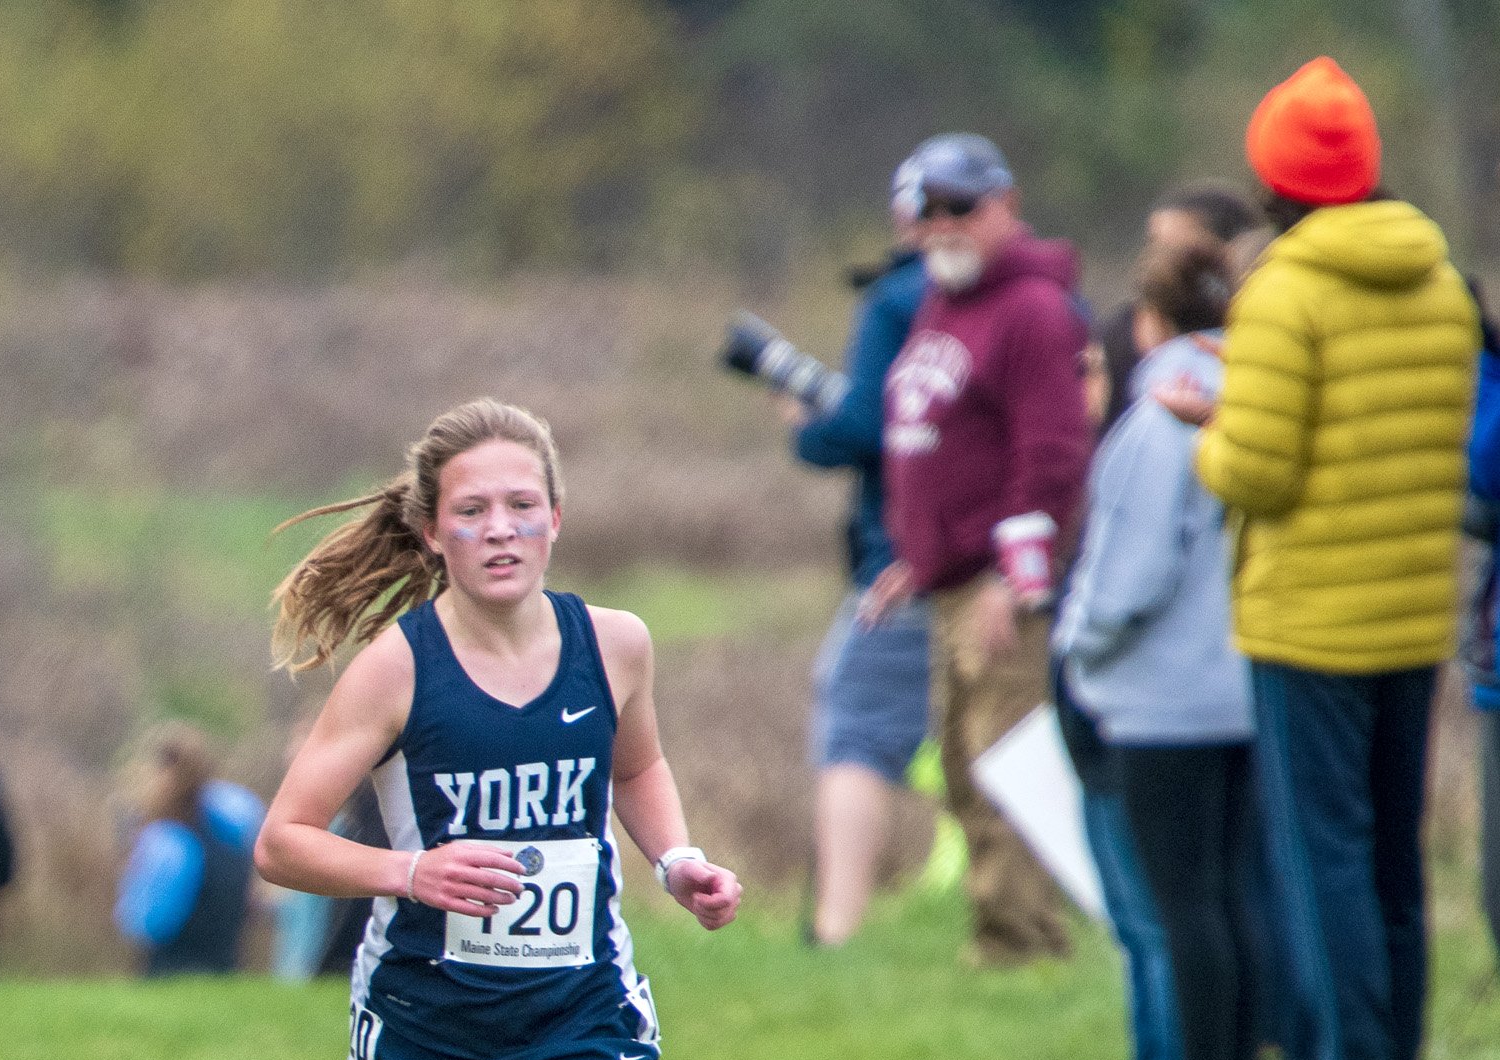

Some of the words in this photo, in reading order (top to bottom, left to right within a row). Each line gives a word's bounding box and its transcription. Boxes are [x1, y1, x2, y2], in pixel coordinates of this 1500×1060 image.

[434, 757, 596, 835] YORK
[460, 939, 492, 955] Maine
[494, 942, 520, 957] State
[522, 941, 581, 960] Championship
